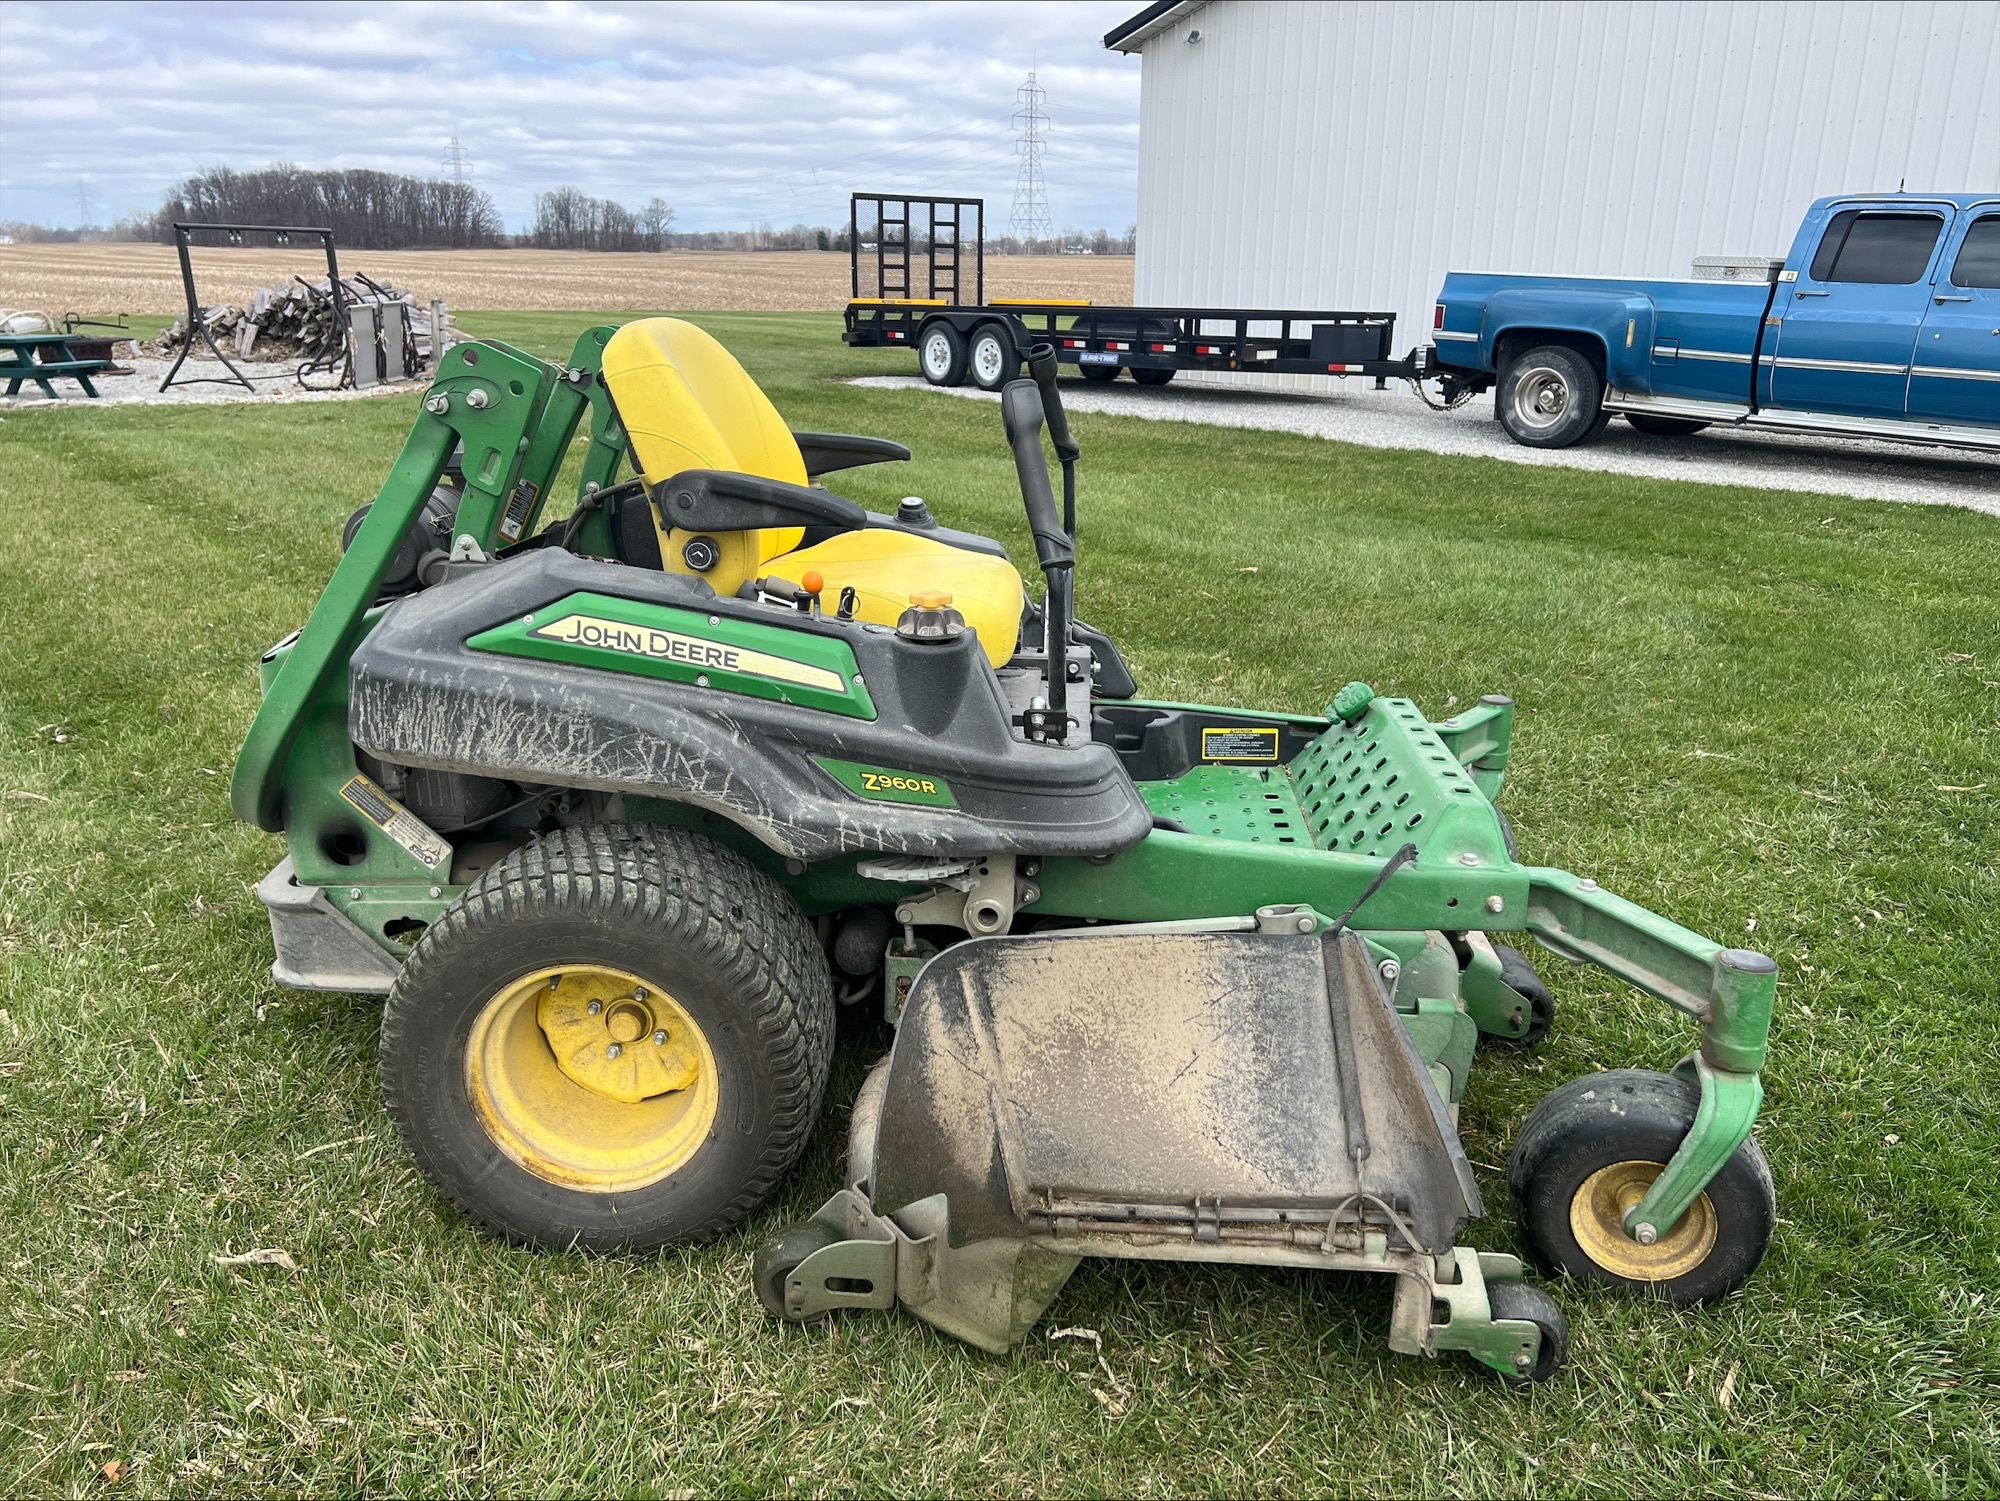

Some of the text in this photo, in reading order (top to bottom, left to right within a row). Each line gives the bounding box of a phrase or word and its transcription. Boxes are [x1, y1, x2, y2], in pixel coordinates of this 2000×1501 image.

[566, 619, 740, 670] JOHN DEERE
[860, 772, 938, 794] Z960R
